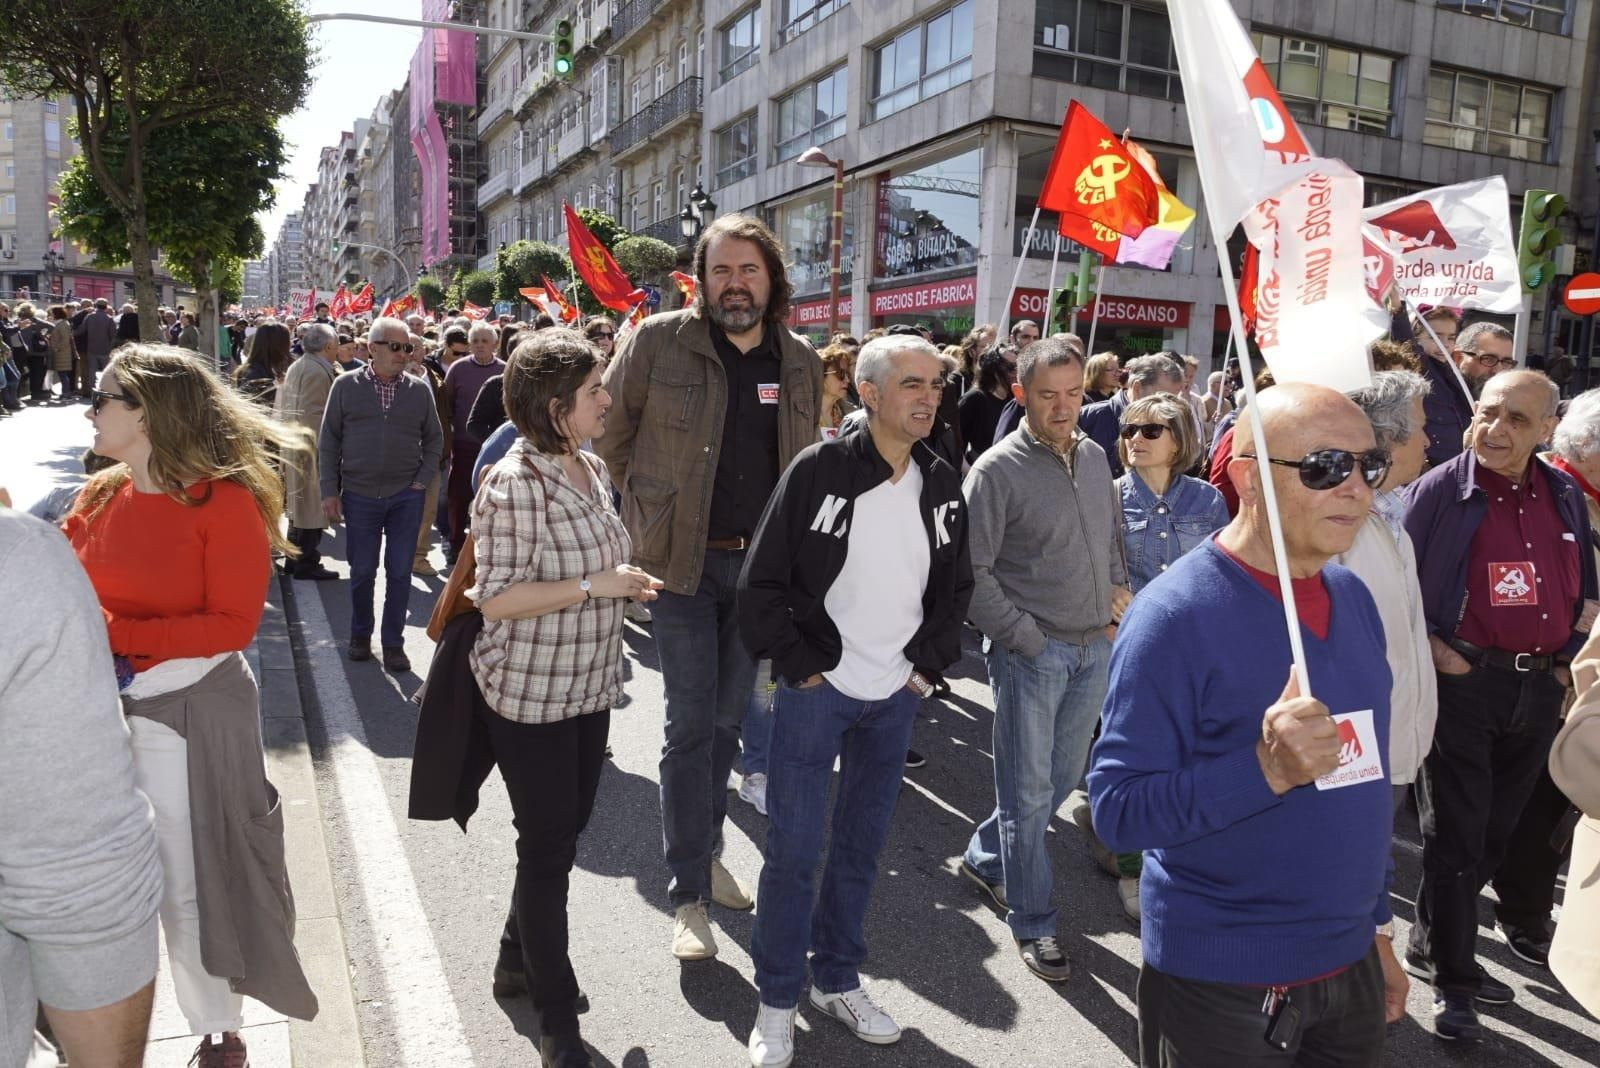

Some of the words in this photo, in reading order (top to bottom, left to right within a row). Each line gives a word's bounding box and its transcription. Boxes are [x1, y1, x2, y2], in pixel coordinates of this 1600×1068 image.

[1395, 258, 1435, 279] erda
[1441, 260, 1494, 281] unida
[876, 293, 914, 312] PRECIOS
[915, 290, 928, 306] DE
[930, 284, 974, 305] FABRICA
[800, 306, 815, 321] VENTA
[815, 304, 823, 319] DE
[1097, 302, 1178, 323] DESCANSO
[1359, 765, 1379, 778] unida
